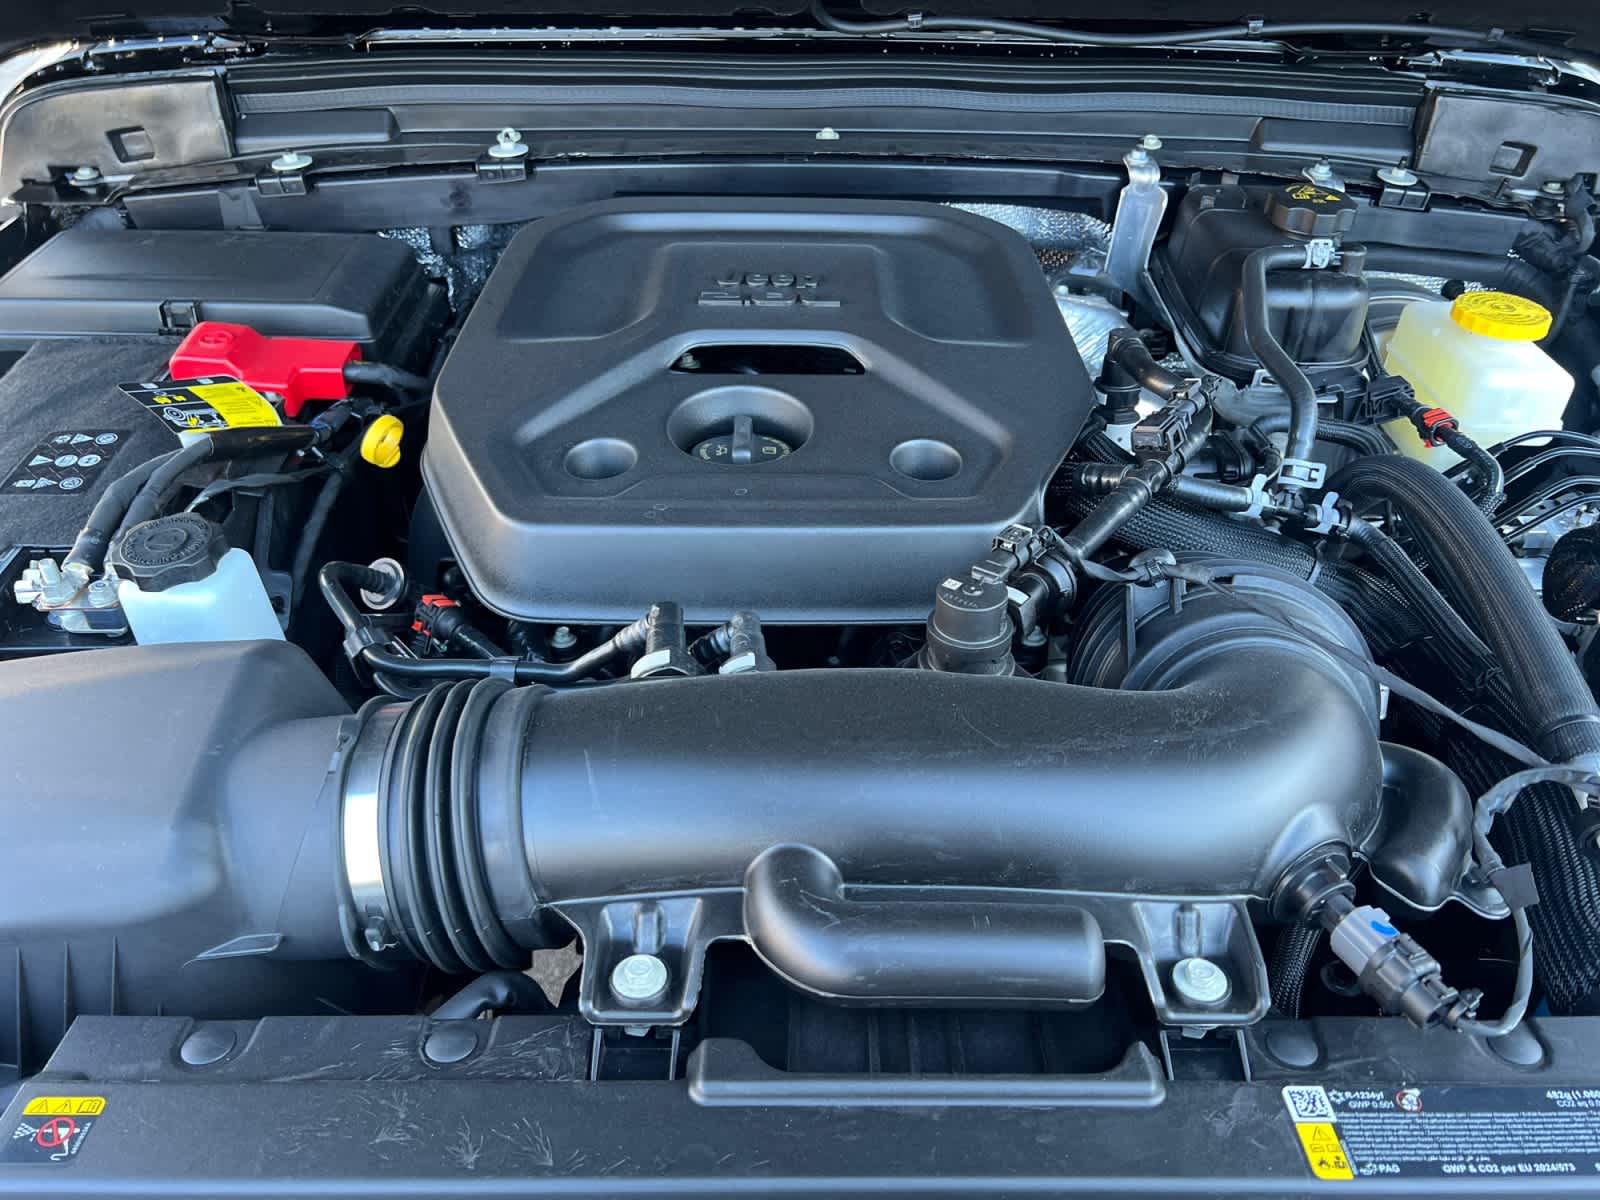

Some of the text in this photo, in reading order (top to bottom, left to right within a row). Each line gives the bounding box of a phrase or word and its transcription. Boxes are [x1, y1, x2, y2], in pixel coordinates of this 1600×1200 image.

[1348, 1100, 1371, 1109] GWP
[1379, 1163, 1401, 1174] PAG
[1442, 1163, 1466, 1174] GWP
[1468, 1163, 1477, 1174] &
[1478, 1163, 1499, 1174] CO2
[1500, 1164, 1516, 1175] per
[1517, 1163, 1533, 1173] EU
